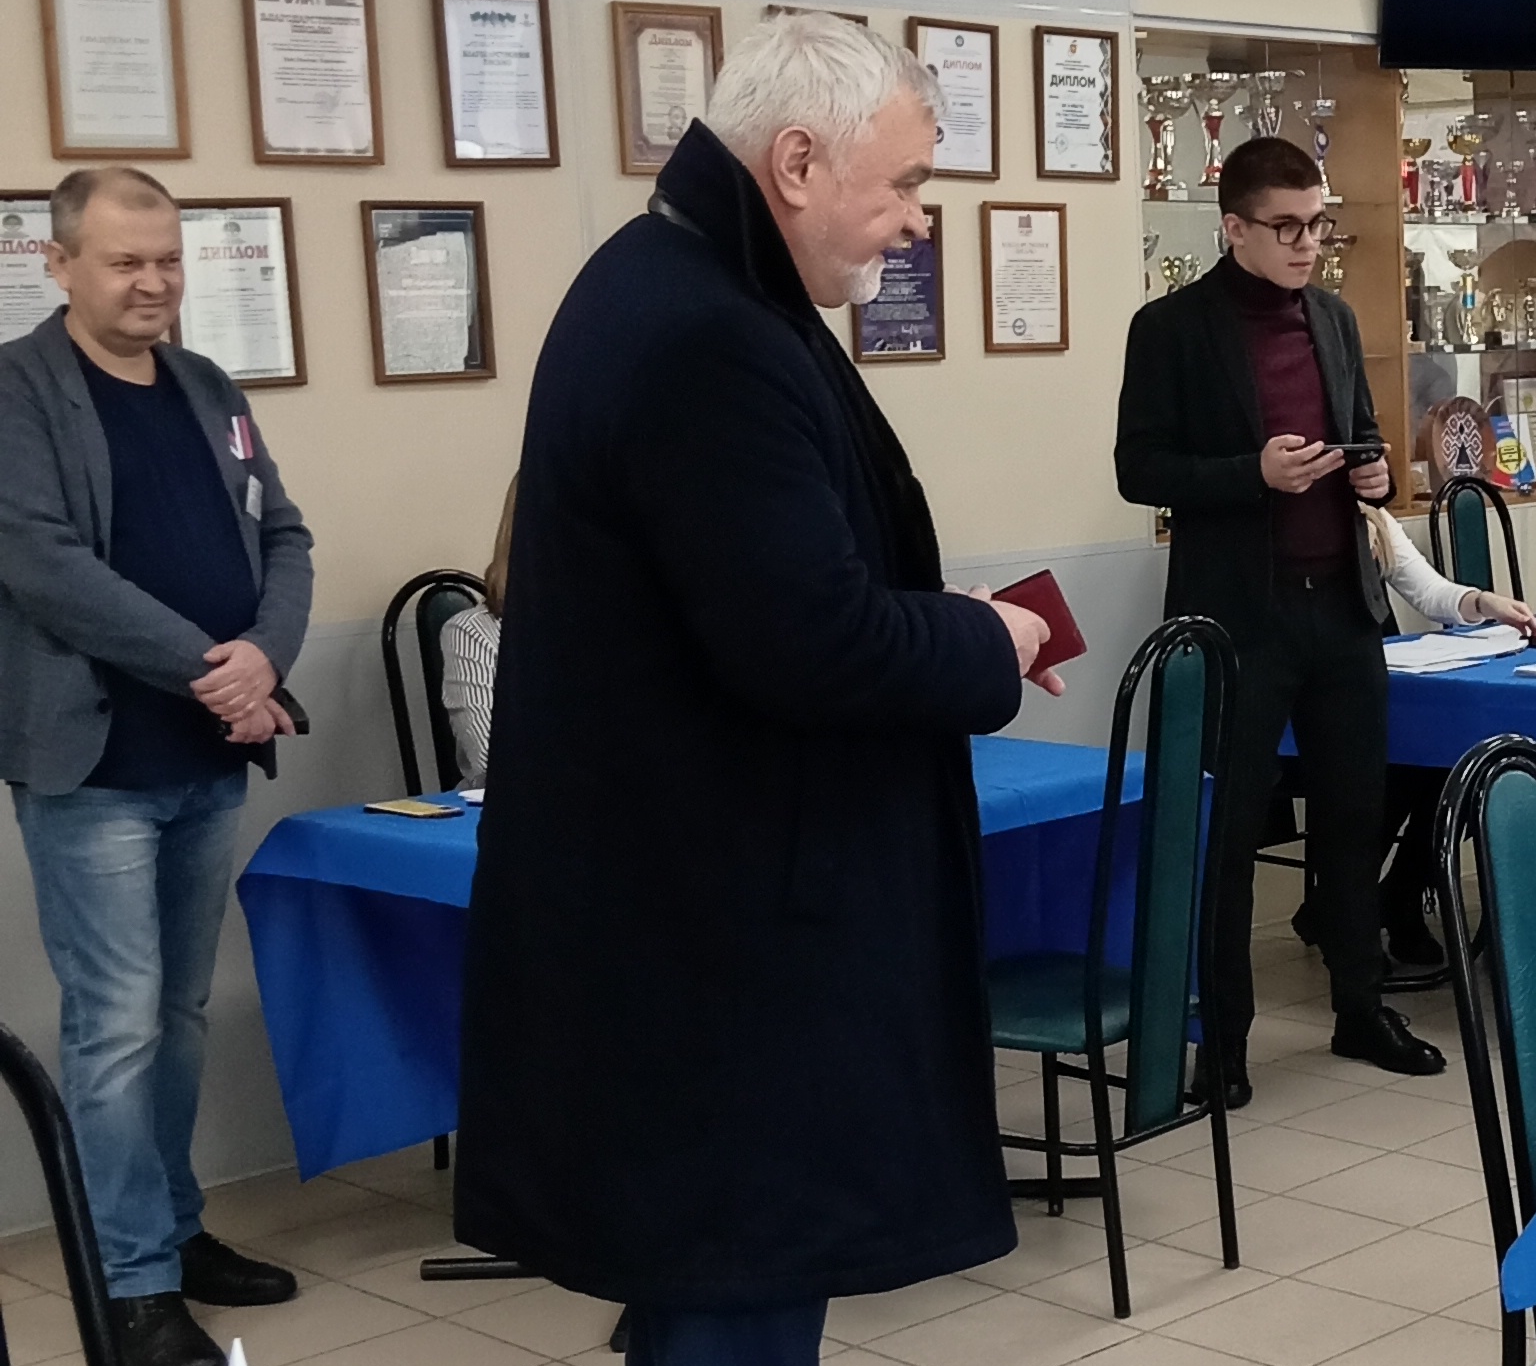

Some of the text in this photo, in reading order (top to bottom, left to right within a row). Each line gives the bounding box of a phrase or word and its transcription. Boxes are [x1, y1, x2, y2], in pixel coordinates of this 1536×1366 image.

[943, 59, 982, 71] ДИПЛОМ
[1050, 74, 1096, 88] ДИПЛОМ
[198, 245, 269, 261] ДИПЛОМ
